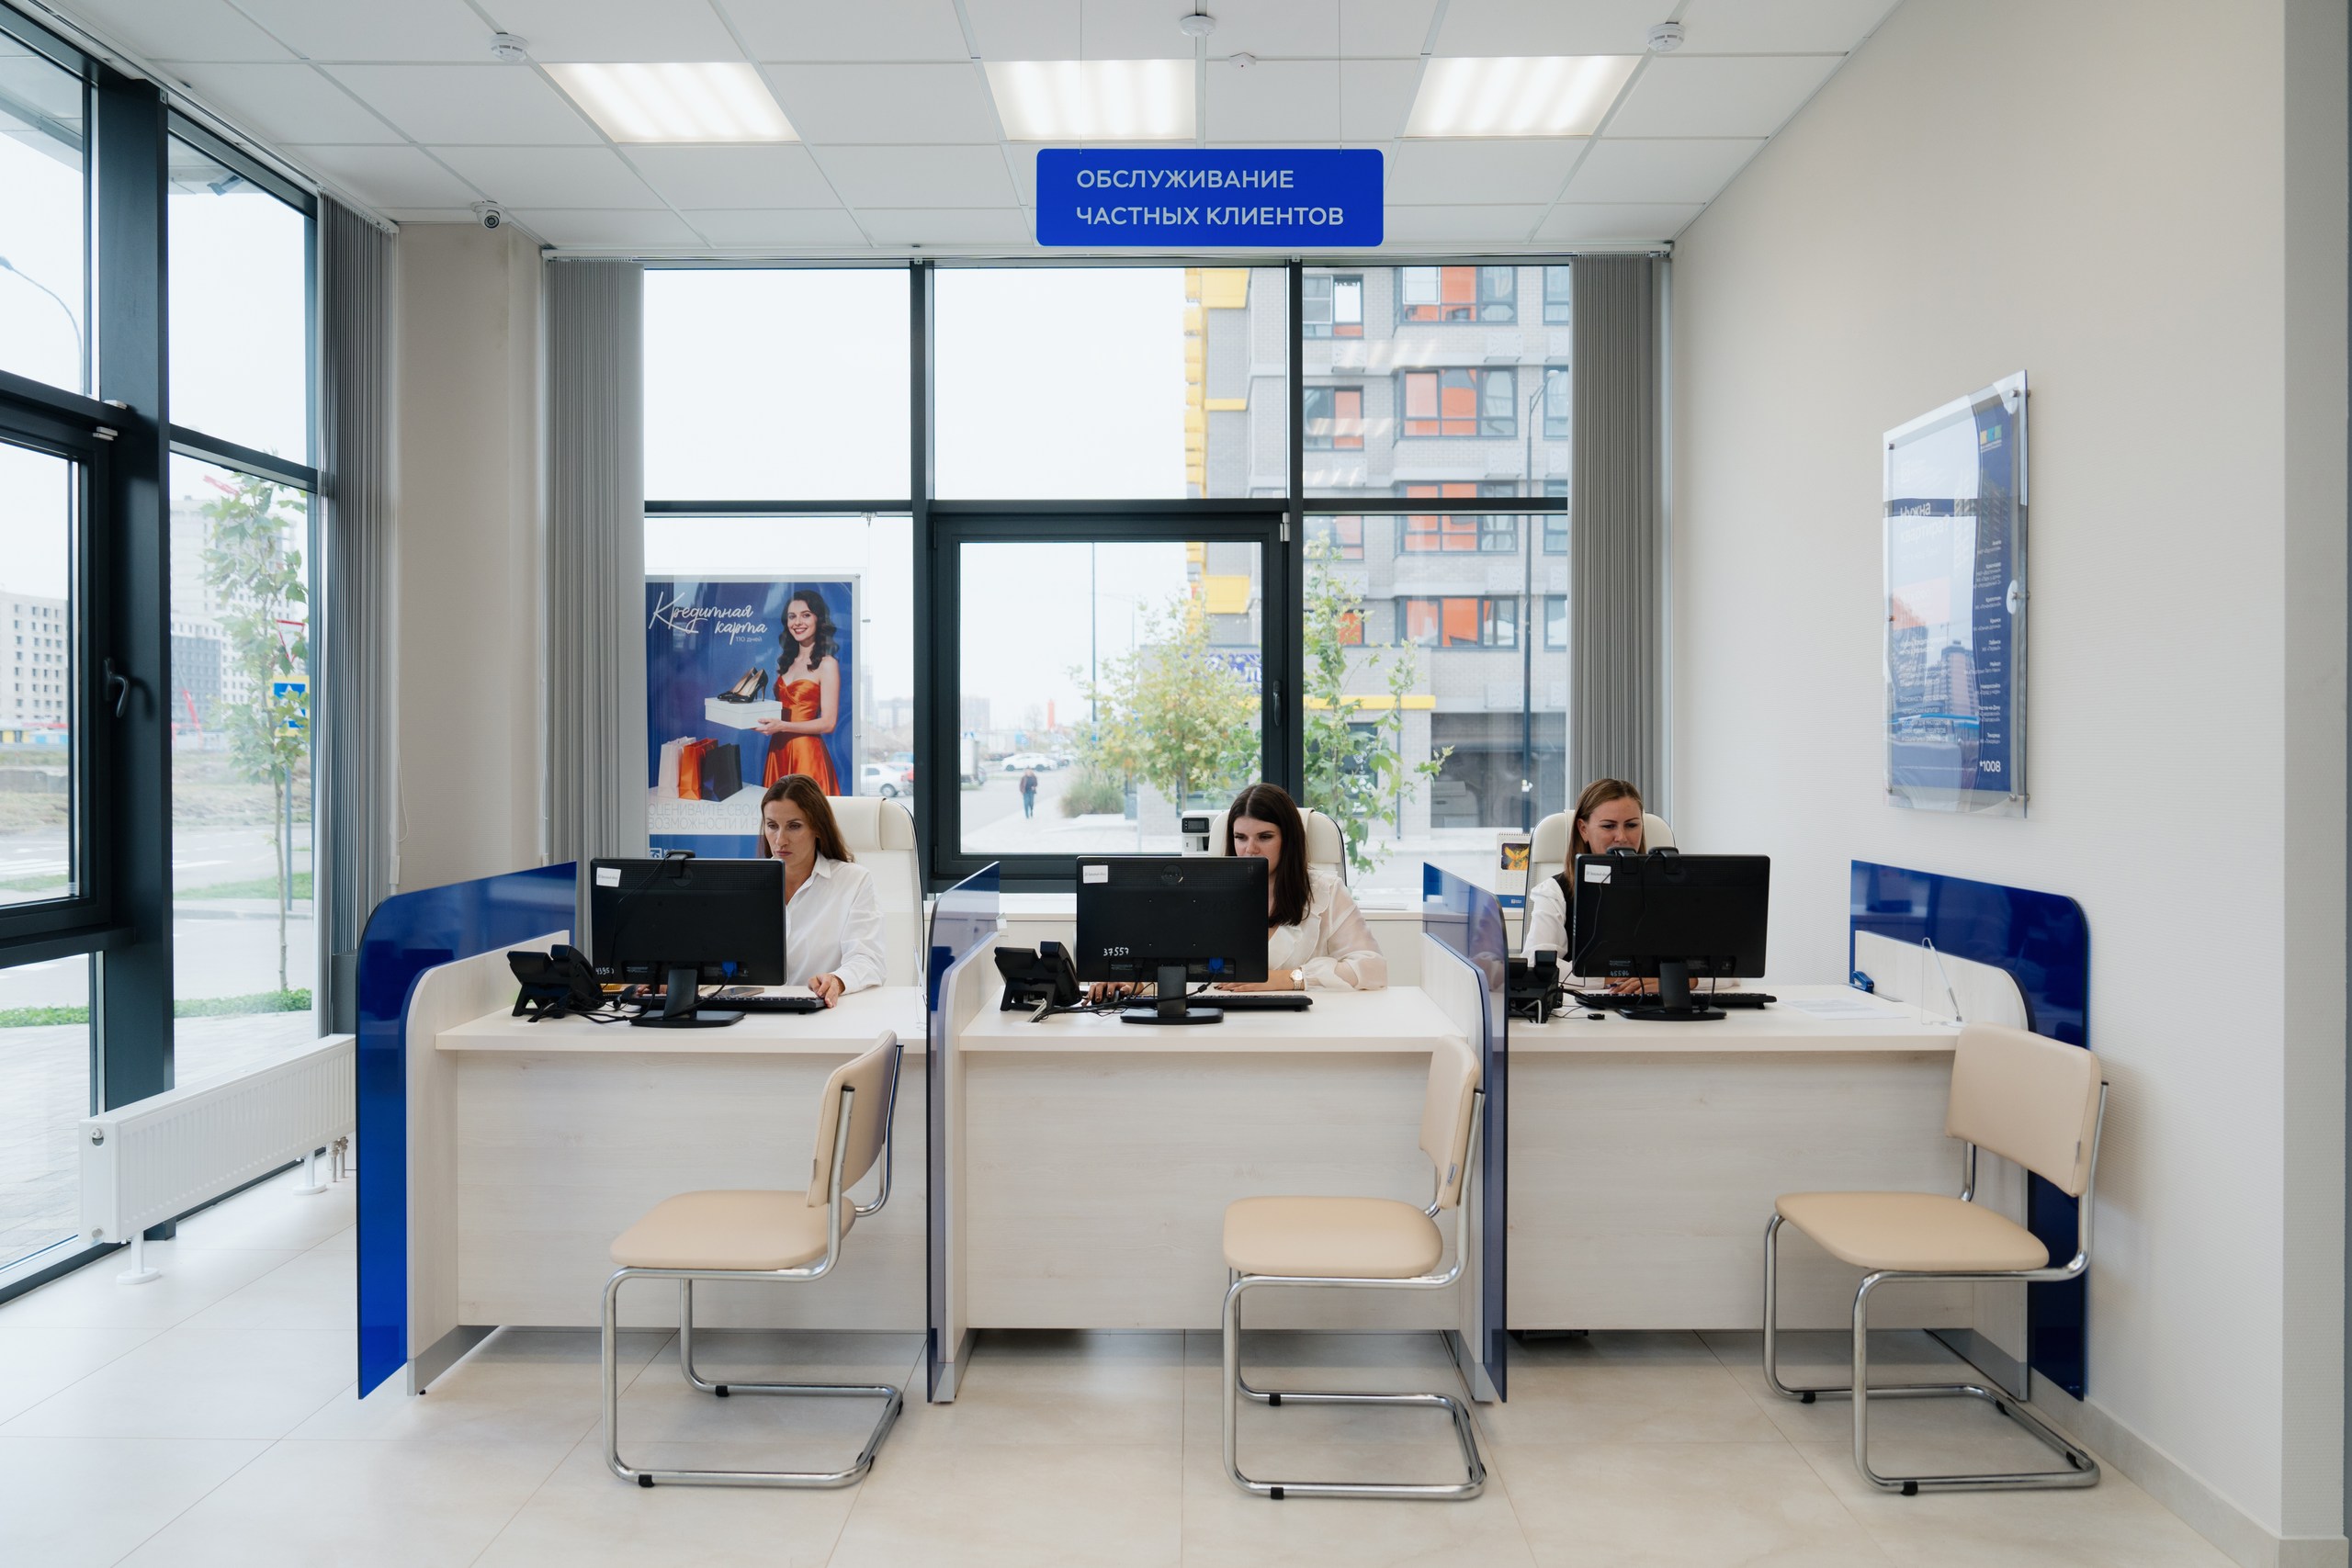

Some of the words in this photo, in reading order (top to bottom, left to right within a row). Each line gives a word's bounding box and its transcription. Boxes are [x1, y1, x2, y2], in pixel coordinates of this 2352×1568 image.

[1077, 170, 1294, 188] ОБСЛУЖИВАНИЕ
[1076, 207, 1199, 225] ЧАСТНЫХ
[1206, 207, 1344, 225] КЛИЕНТОВ
[648, 591, 753, 634] Кредитная
[714, 620, 768, 646] карта
[648, 800, 724, 817] ОЦЕНИВАЙТЕ
[648, 817, 737, 830] ВОЗМОЖНОСТИ
[1102, 946, 1130, 957] 37557
